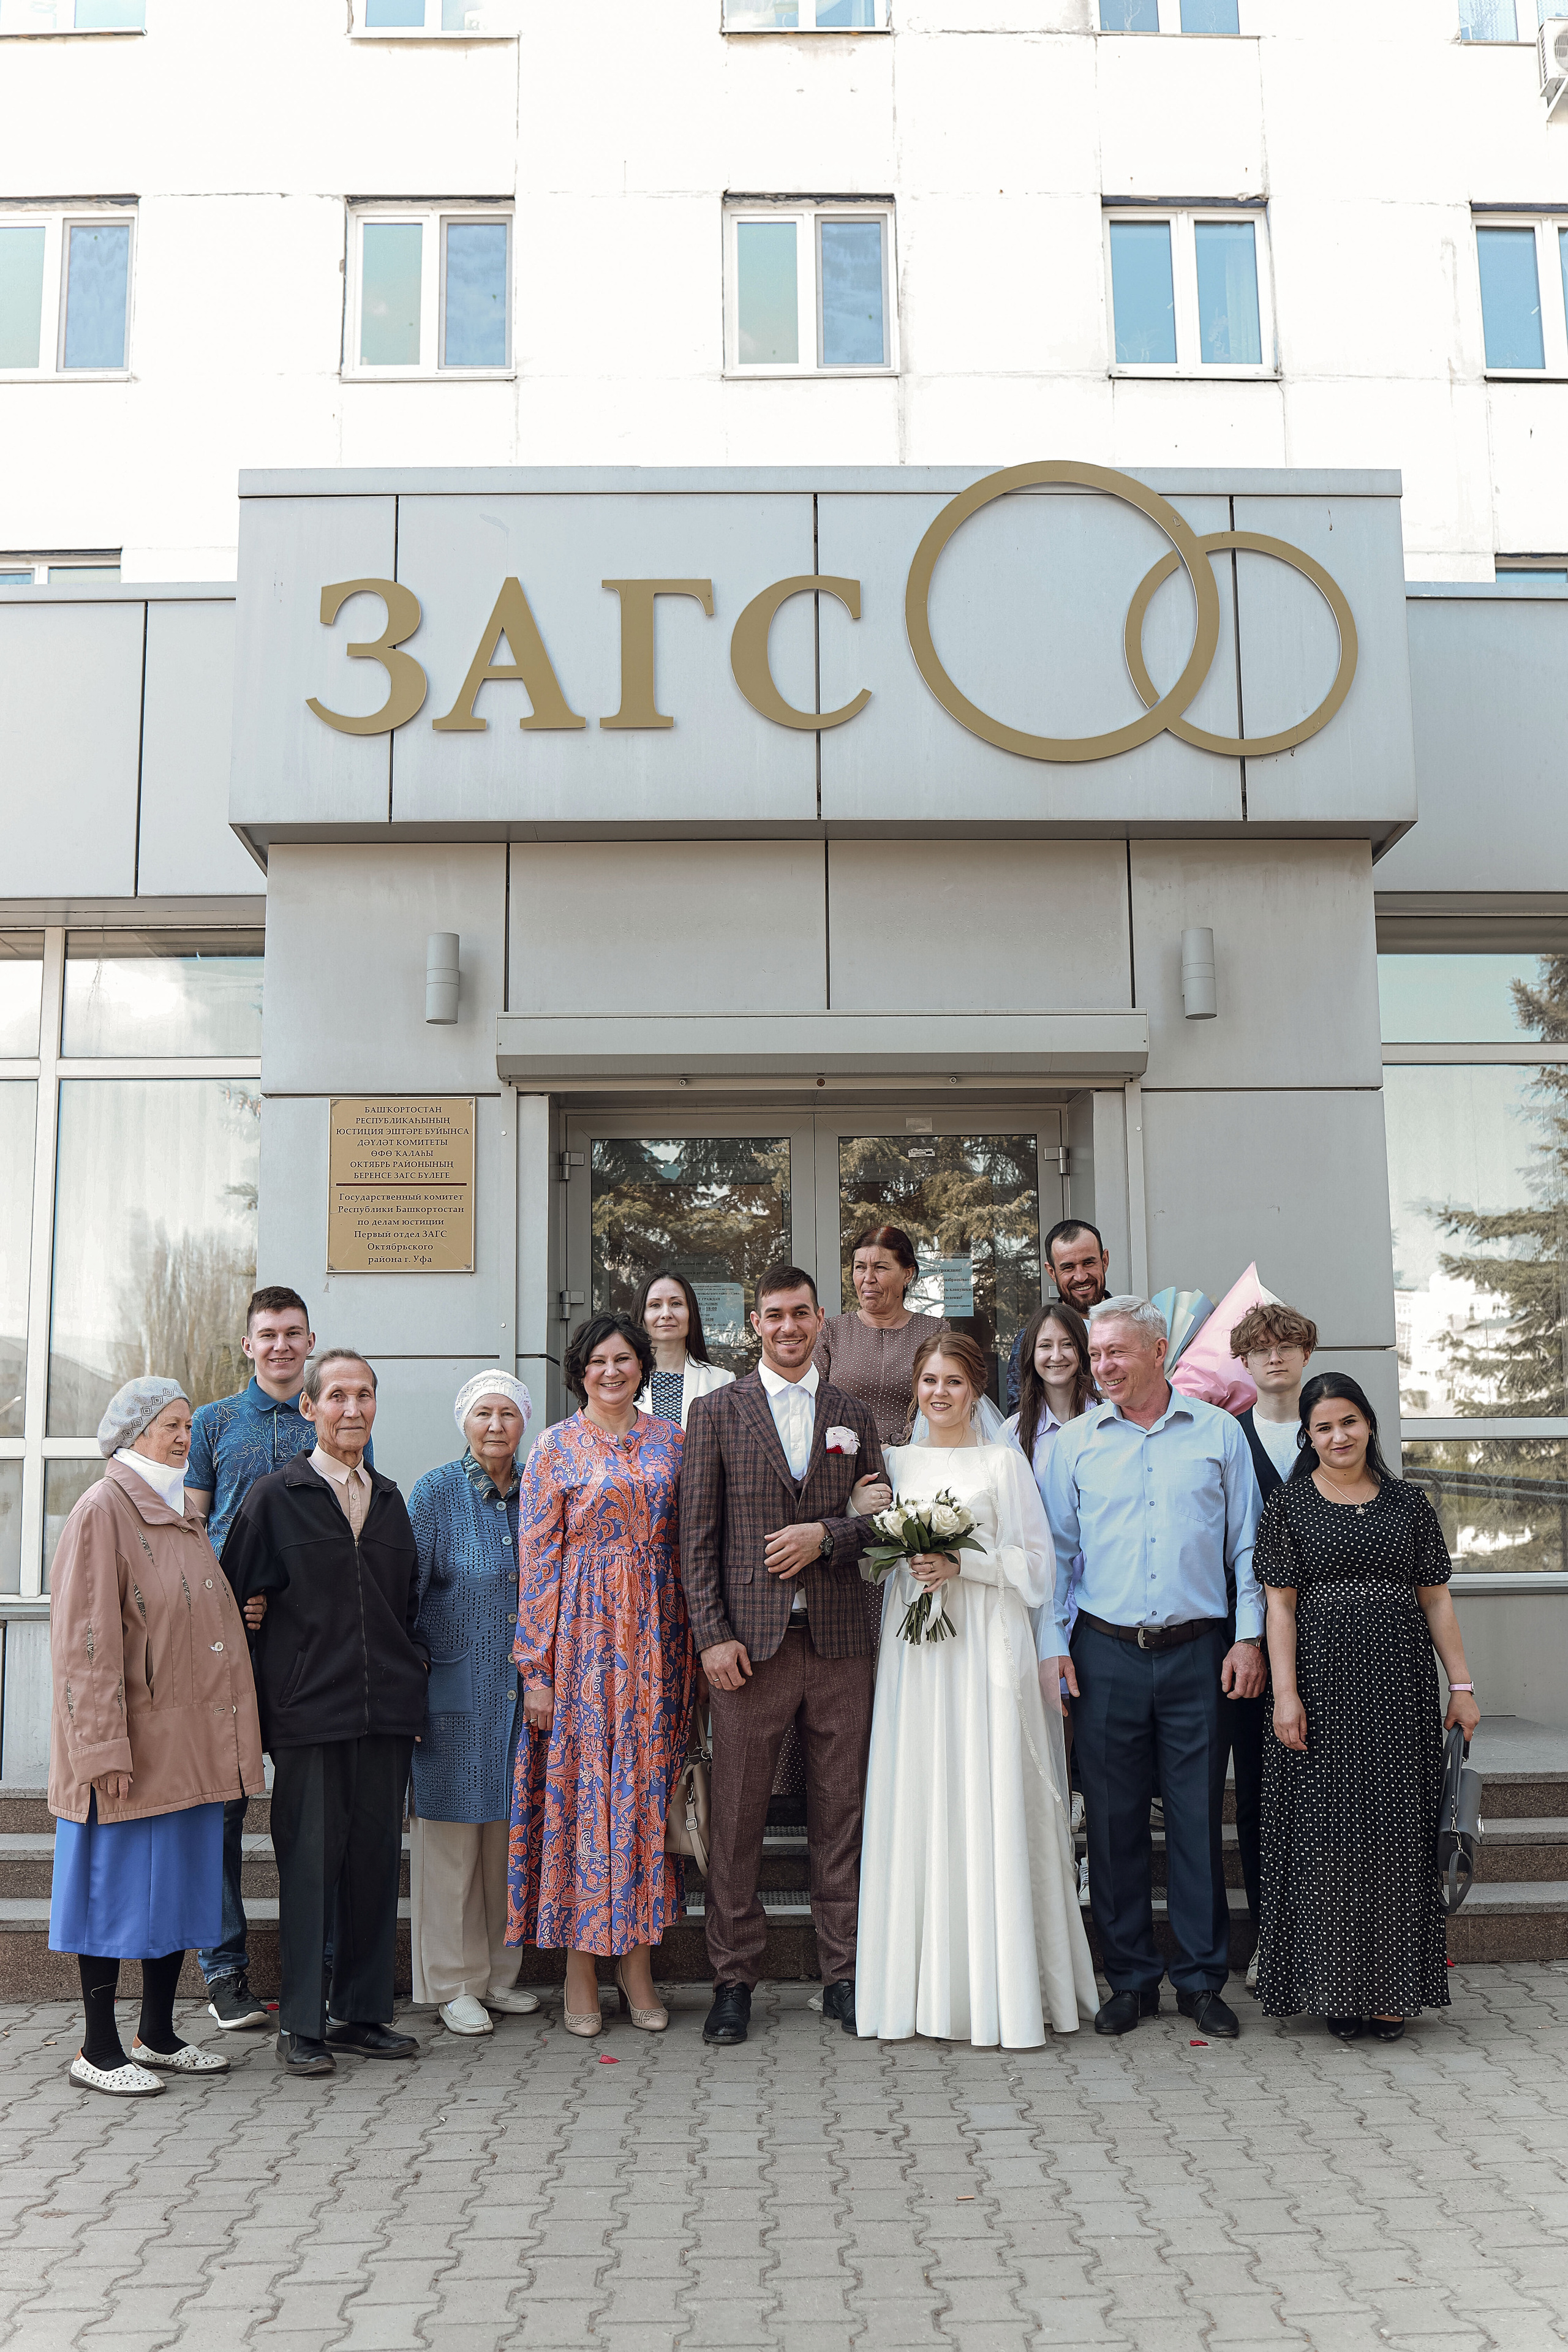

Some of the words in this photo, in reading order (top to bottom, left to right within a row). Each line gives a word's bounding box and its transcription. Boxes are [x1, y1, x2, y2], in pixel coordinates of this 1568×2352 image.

[305, 575, 873, 735] ЗАГС
[425, 1126, 469, 1135] БУЙЫНСА
[393, 1159, 454, 1169] РАЙОНЫНЫҢ
[339, 1193, 421, 1203] Государственный
[337, 1205, 393, 1215] Республики
[396, 1205, 464, 1215] Башкортостан
[354, 1231, 391, 1240] Первый
[367, 1243, 434, 1253] Октябрьского
[368, 1256, 402, 1265] района
[413, 1255, 432, 1265] Уфа
